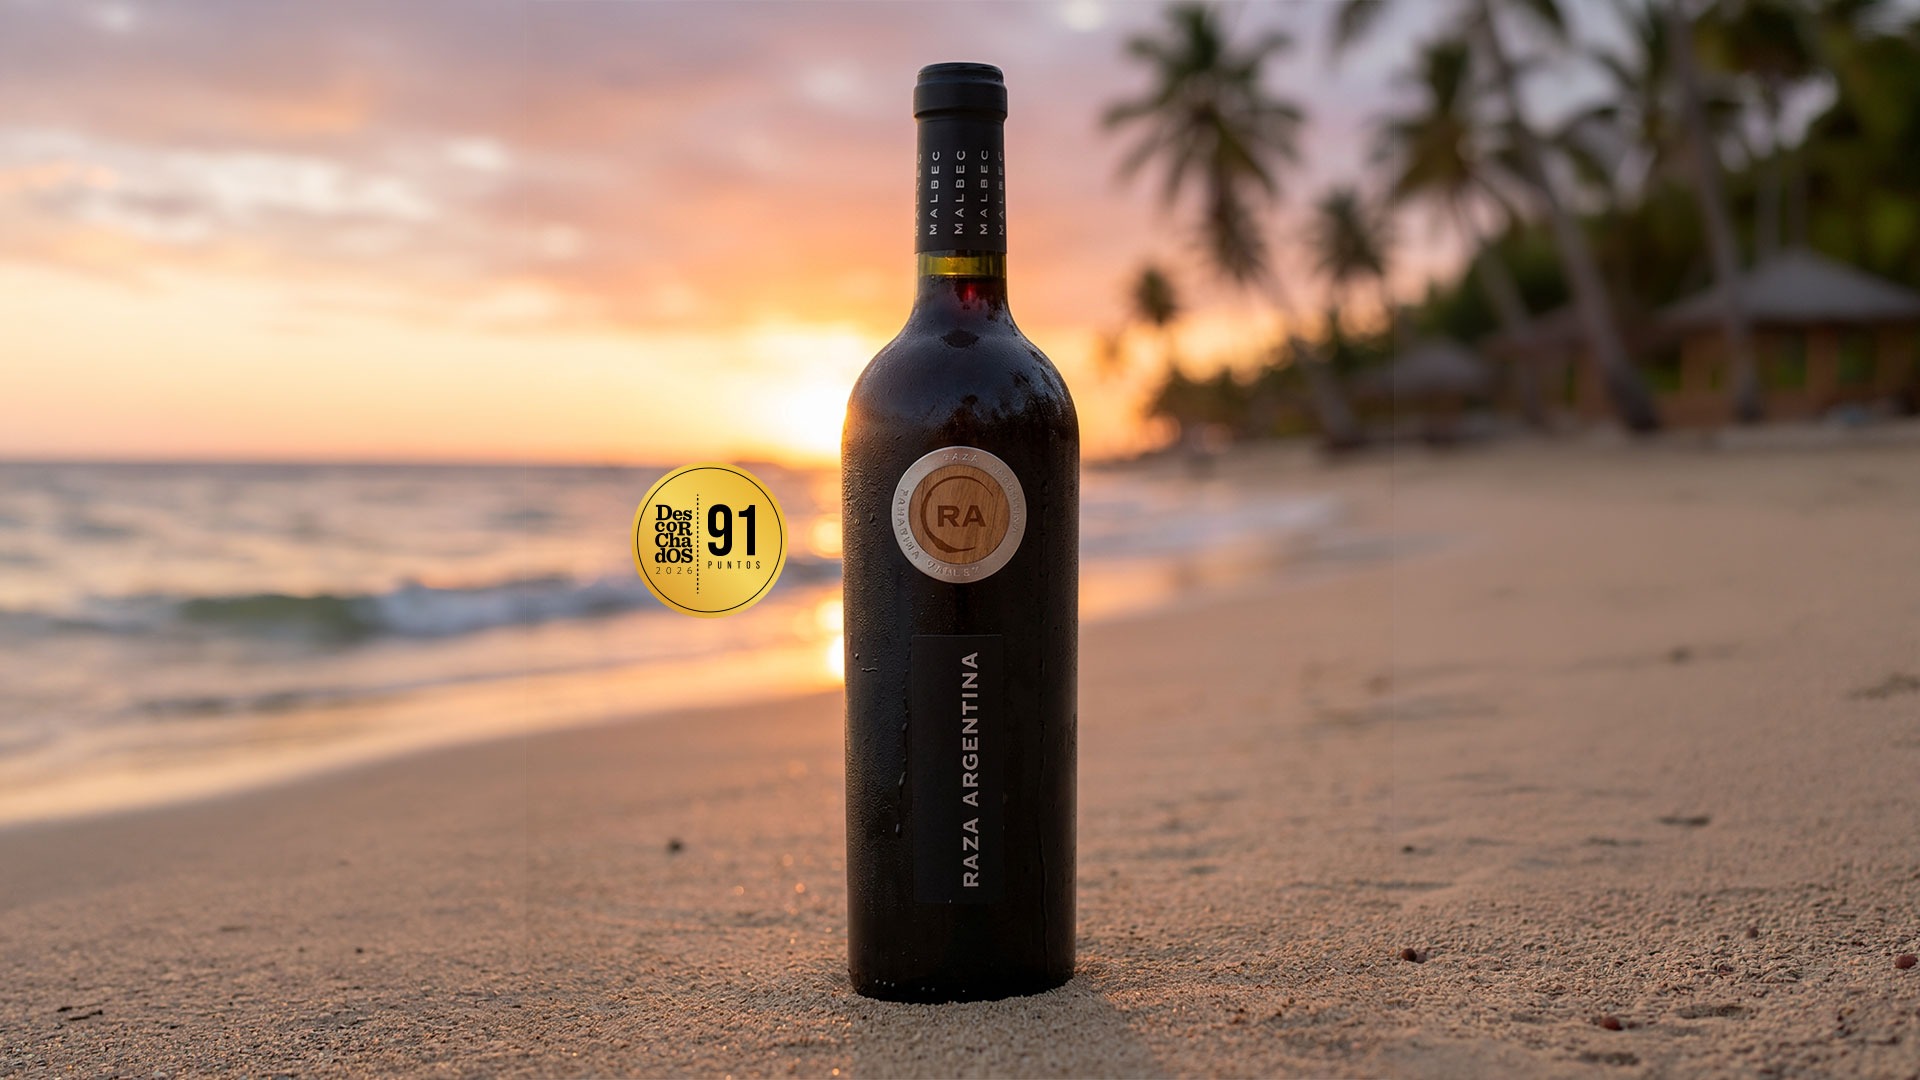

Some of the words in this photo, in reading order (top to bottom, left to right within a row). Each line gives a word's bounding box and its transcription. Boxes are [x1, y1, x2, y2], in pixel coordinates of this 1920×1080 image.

[929, 151, 940, 235] MALBEC
[954, 150, 966, 235] MALBEC
[980, 150, 989, 235] MALBEC
[937, 505, 986, 528] RA
[962, 652, 979, 807] ARGENTINA
[963, 817, 979, 887] RAZA
